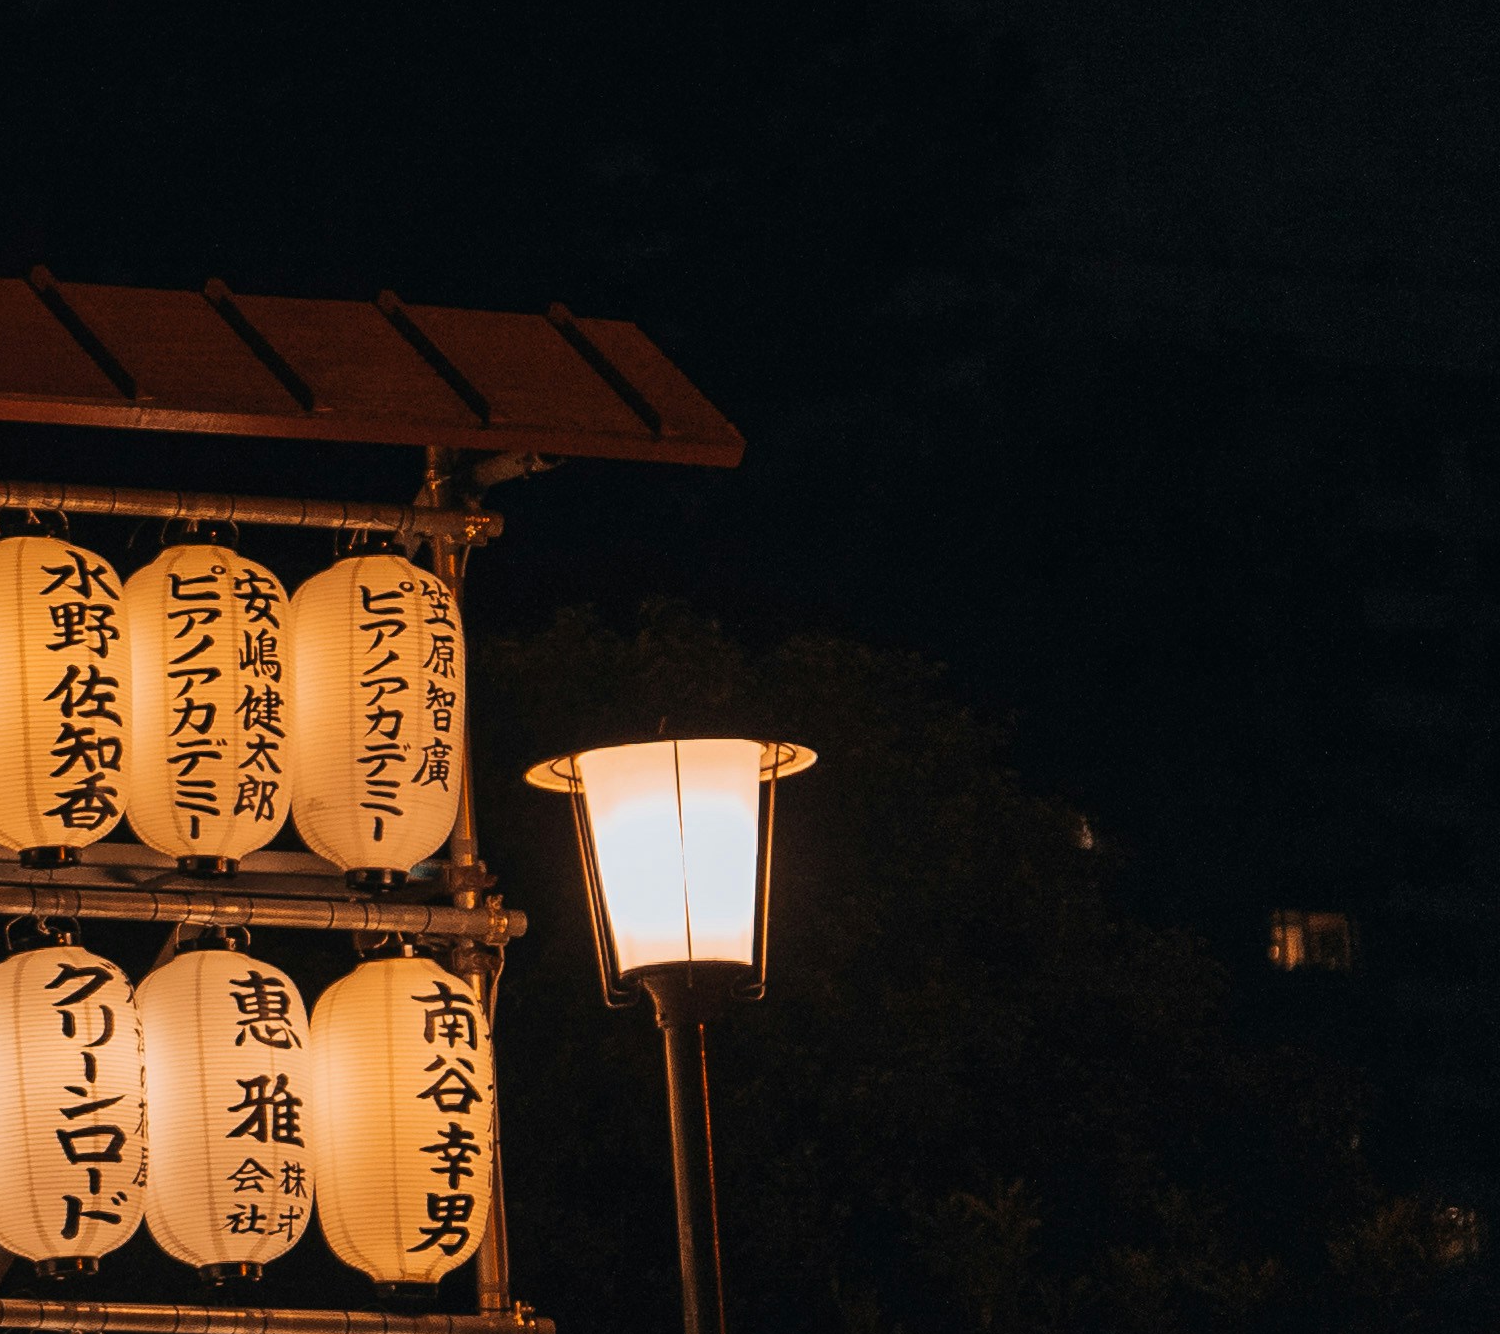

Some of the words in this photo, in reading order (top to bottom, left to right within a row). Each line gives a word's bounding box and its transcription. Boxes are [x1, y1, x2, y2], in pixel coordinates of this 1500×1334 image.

[40, 550, 124, 832] 水野佐知香
[167, 564, 227, 840] ピアノアカデミー
[233, 569, 286, 824] 安嶋健太郎
[357, 580, 414, 842] ピアノアカデミー
[44, 963, 129, 1241] クリーンロード
[407, 980, 484, 1257] 南谷幸男
